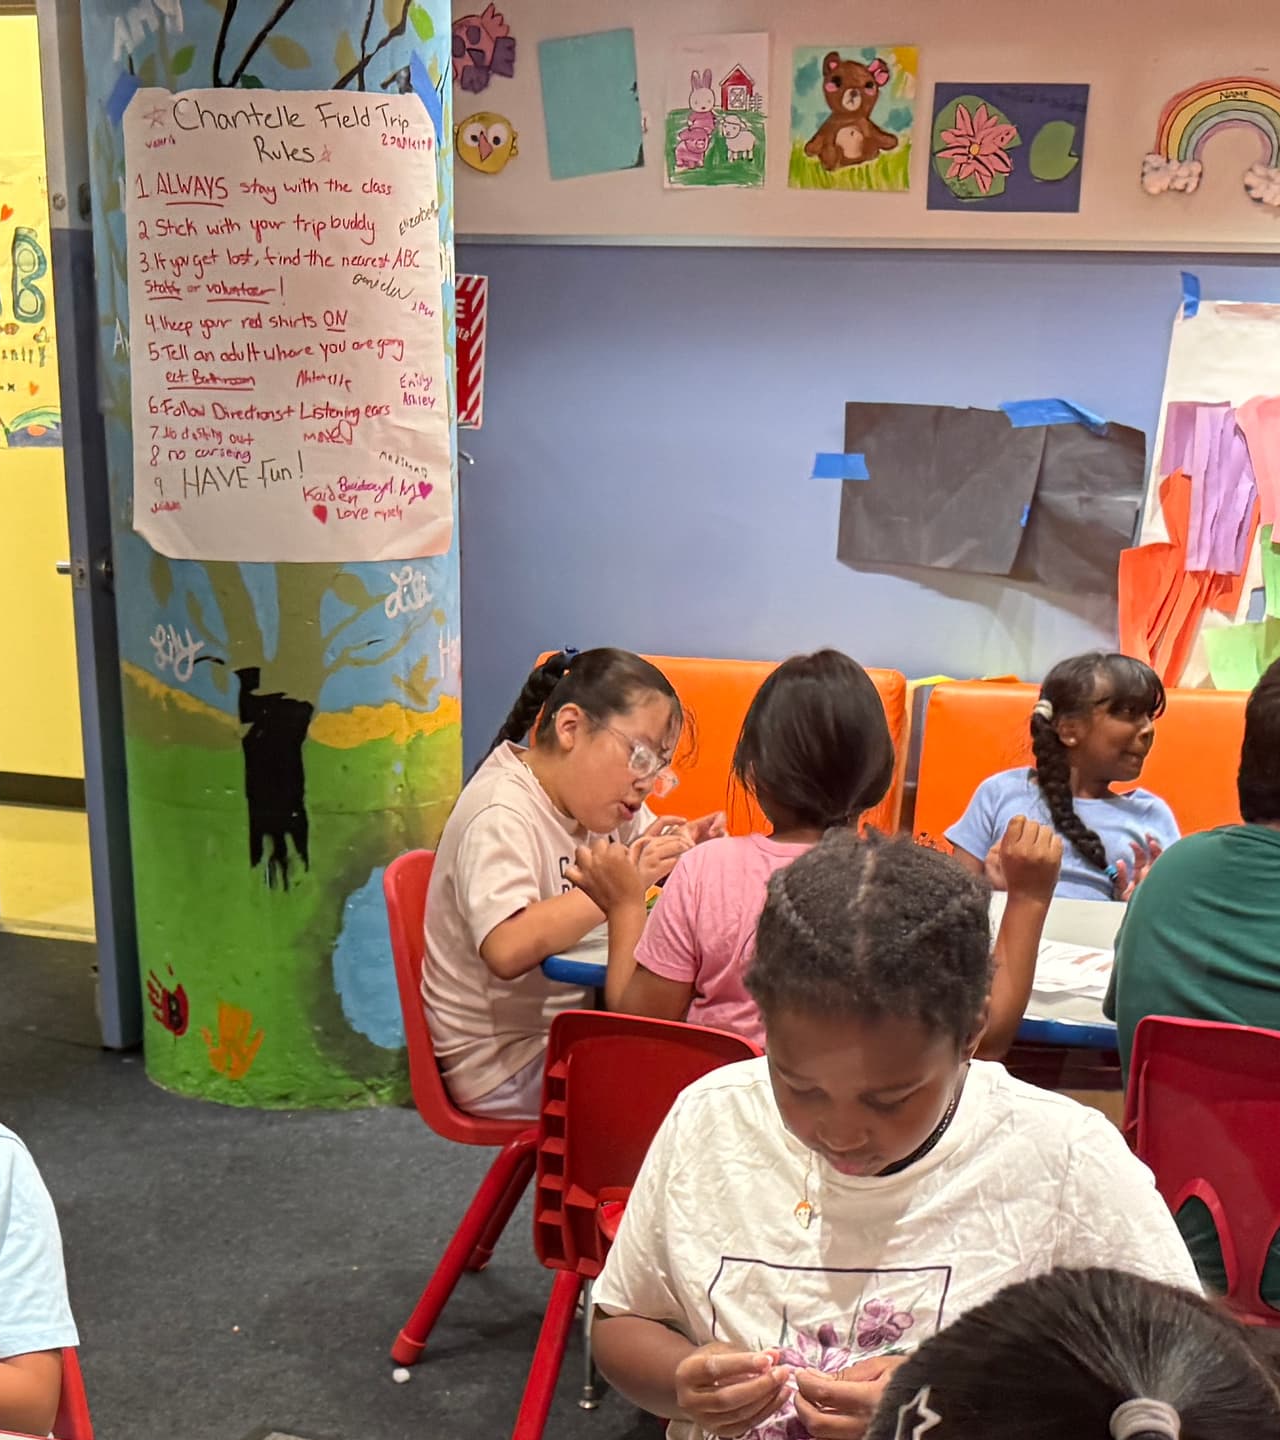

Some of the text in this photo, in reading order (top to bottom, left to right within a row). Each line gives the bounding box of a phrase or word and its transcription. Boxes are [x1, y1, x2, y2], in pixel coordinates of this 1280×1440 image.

[172, 97, 410, 134] Chantelle Field Trip
[253, 135, 316, 163] Rules
[157, 172, 229, 200] ALWAYS
[240, 177, 277, 204] stay
[284, 177, 319, 193] with
[324, 178, 353, 193] the
[362, 177, 392, 195] class
[156, 217, 197, 236] Stick
[207, 217, 241, 235] with
[250, 219, 286, 243] your
[293, 213, 326, 241] trip
[330, 212, 376, 245] buddy
[193, 248, 219, 279] get
[265, 246, 301, 266] find
[304, 249, 335, 267] the
[342, 253, 390, 269] nearest
[392, 247, 420, 270] ABC
[187, 284, 200, 293] or
[200, 319, 232, 339] your
[241, 312, 263, 329] red
[269, 311, 317, 329] shirts
[323, 310, 348, 328] ON
[161, 343, 189, 361] Tell
[194, 350, 215, 362] an
[220, 341, 260, 362] adult
[352, 339, 375, 351] are
[160, 398, 205, 417] Follow
[212, 402, 284, 421] Directions
[300, 401, 360, 425] Listening
[365, 403, 391, 419] ears
[229, 433, 254, 445] out
[168, 450, 186, 461] no
[183, 464, 249, 499] HAVE
